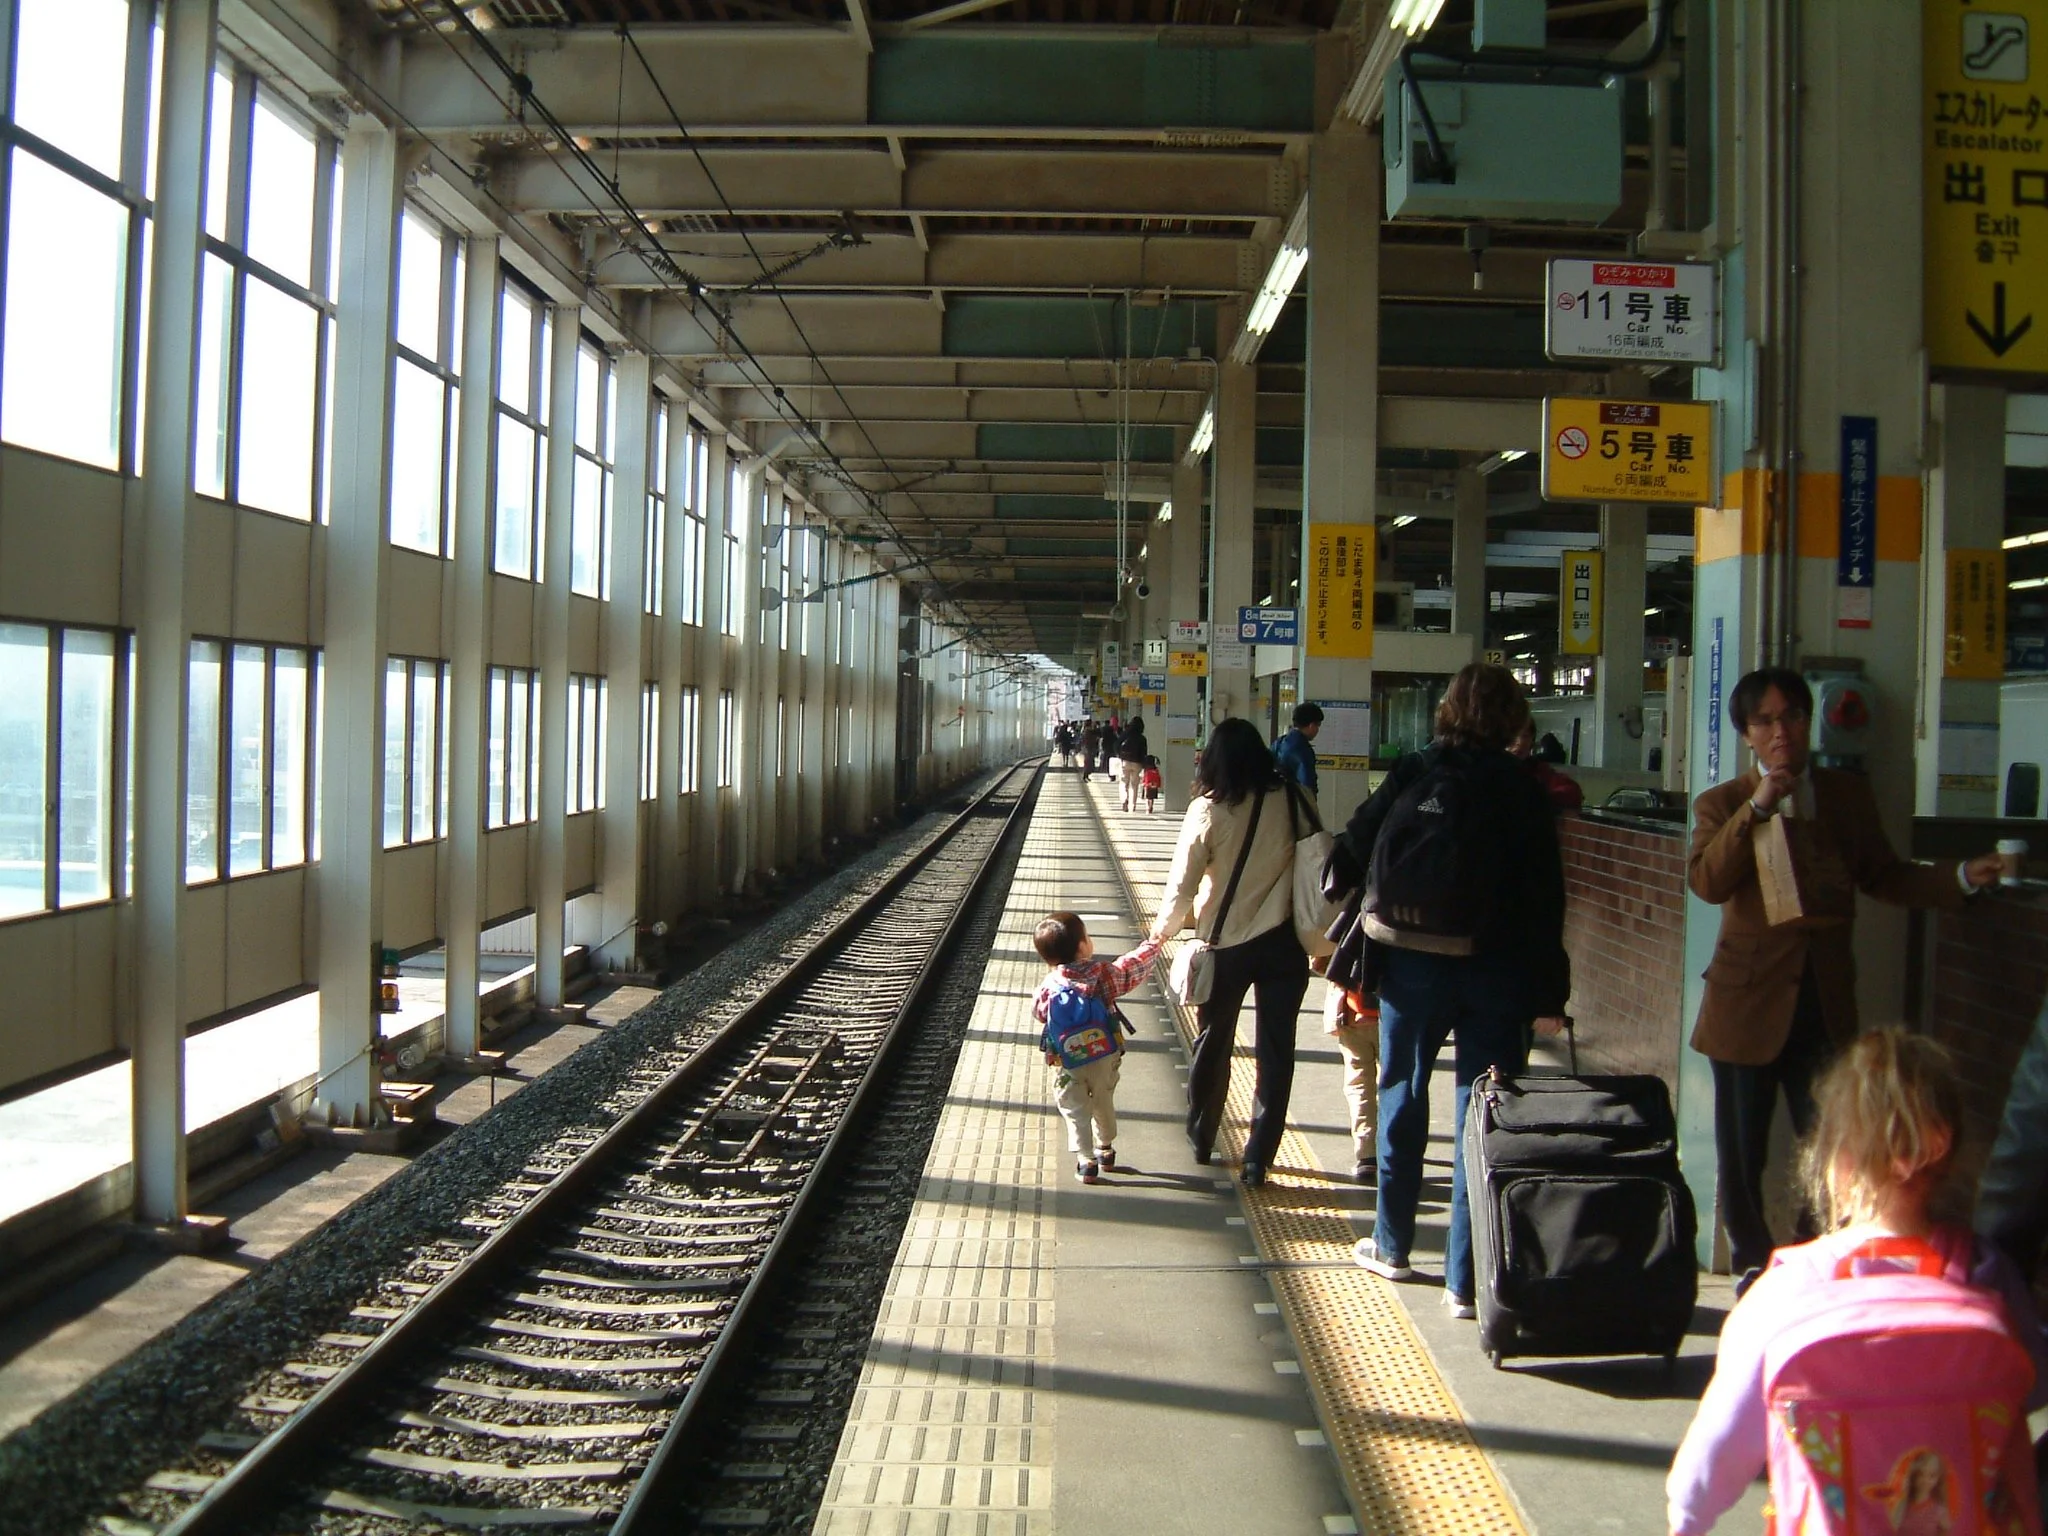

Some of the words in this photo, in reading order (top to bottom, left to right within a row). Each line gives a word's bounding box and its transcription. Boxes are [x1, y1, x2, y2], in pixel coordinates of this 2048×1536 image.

[1934, 129, 2044, 152] Escalator
[1944, 161, 2048, 207] 出口
[1975, 213, 2021, 237] Exit
[1627, 322, 1651, 333] Car
[1666, 324, 1688, 334] No.
[1577, 346, 1612, 354] Number
[1609, 406, 1651, 417] こだま
[1630, 461, 1653, 472] Car
[1668, 463, 1690, 474] No.
[1575, 564, 1590, 601] 出口
[1573, 611, 1589, 620] Exit
[1148, 642, 1162, 654] 11
[1486, 652, 1501, 664] 12
[1417, 805, 1444, 814] adidas
